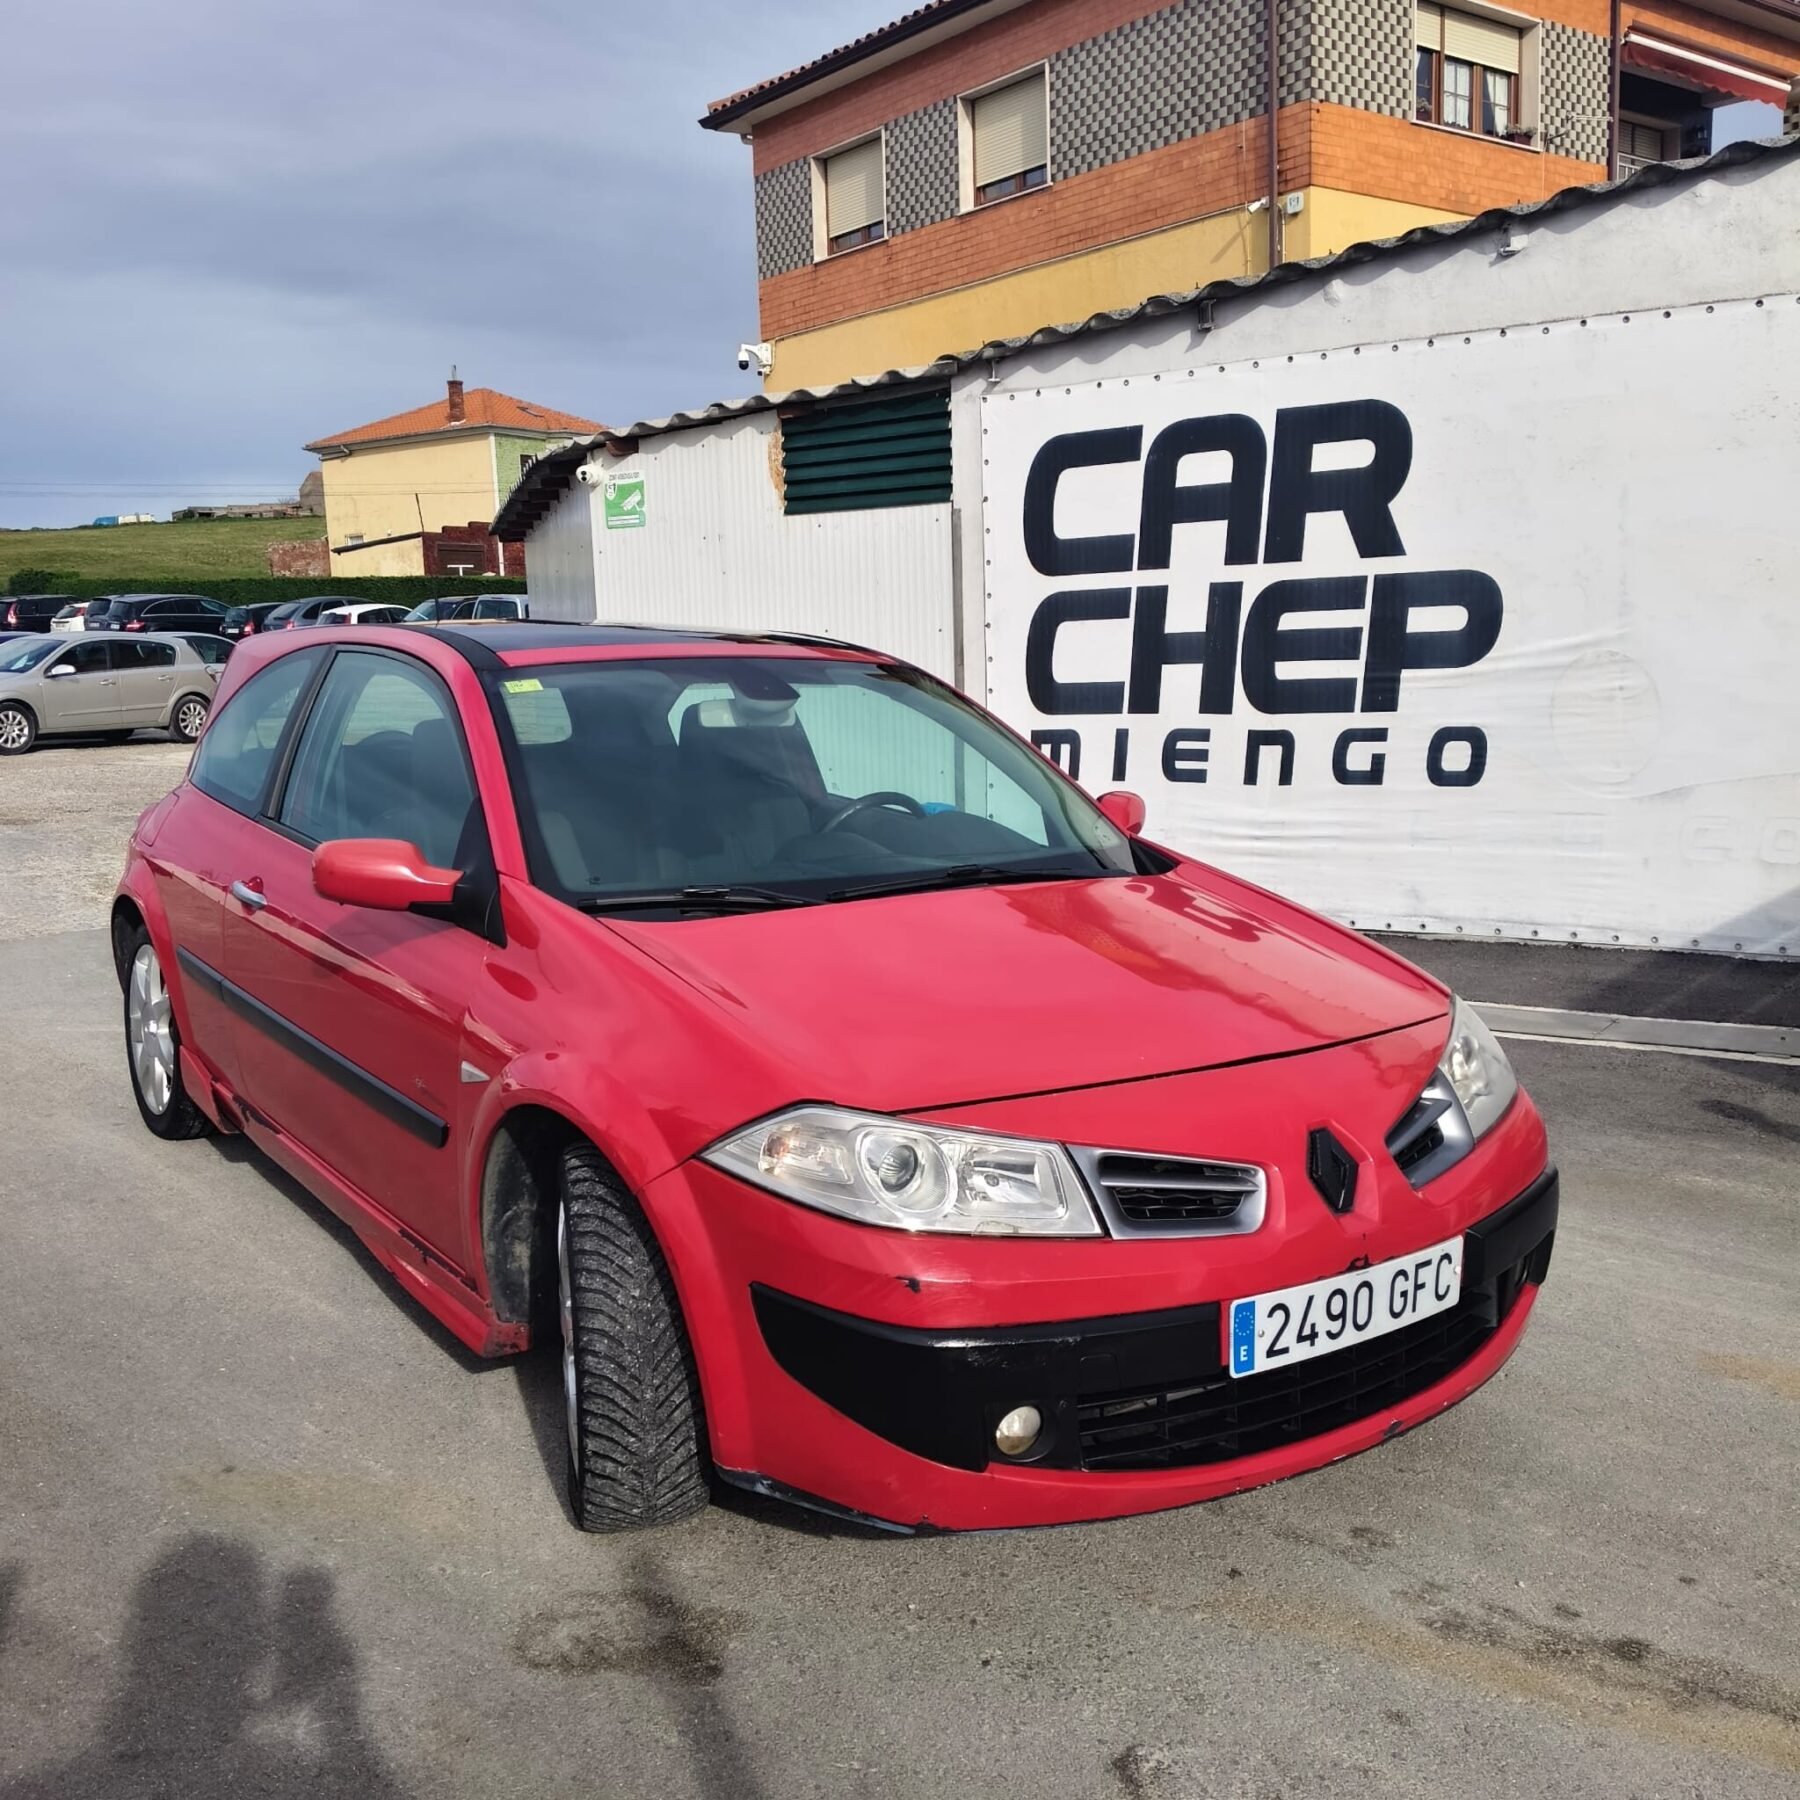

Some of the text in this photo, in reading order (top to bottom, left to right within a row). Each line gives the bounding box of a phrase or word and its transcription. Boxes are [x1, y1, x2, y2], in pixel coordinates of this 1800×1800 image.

[1023, 398, 1414, 577] CAR
[1025, 569, 1504, 715] CHEP
[1030, 725, 1488, 787] MIENGO
[1240, 1344, 1249, 1362] E
[1265, 1252, 1453, 1359] 2490 GFC
